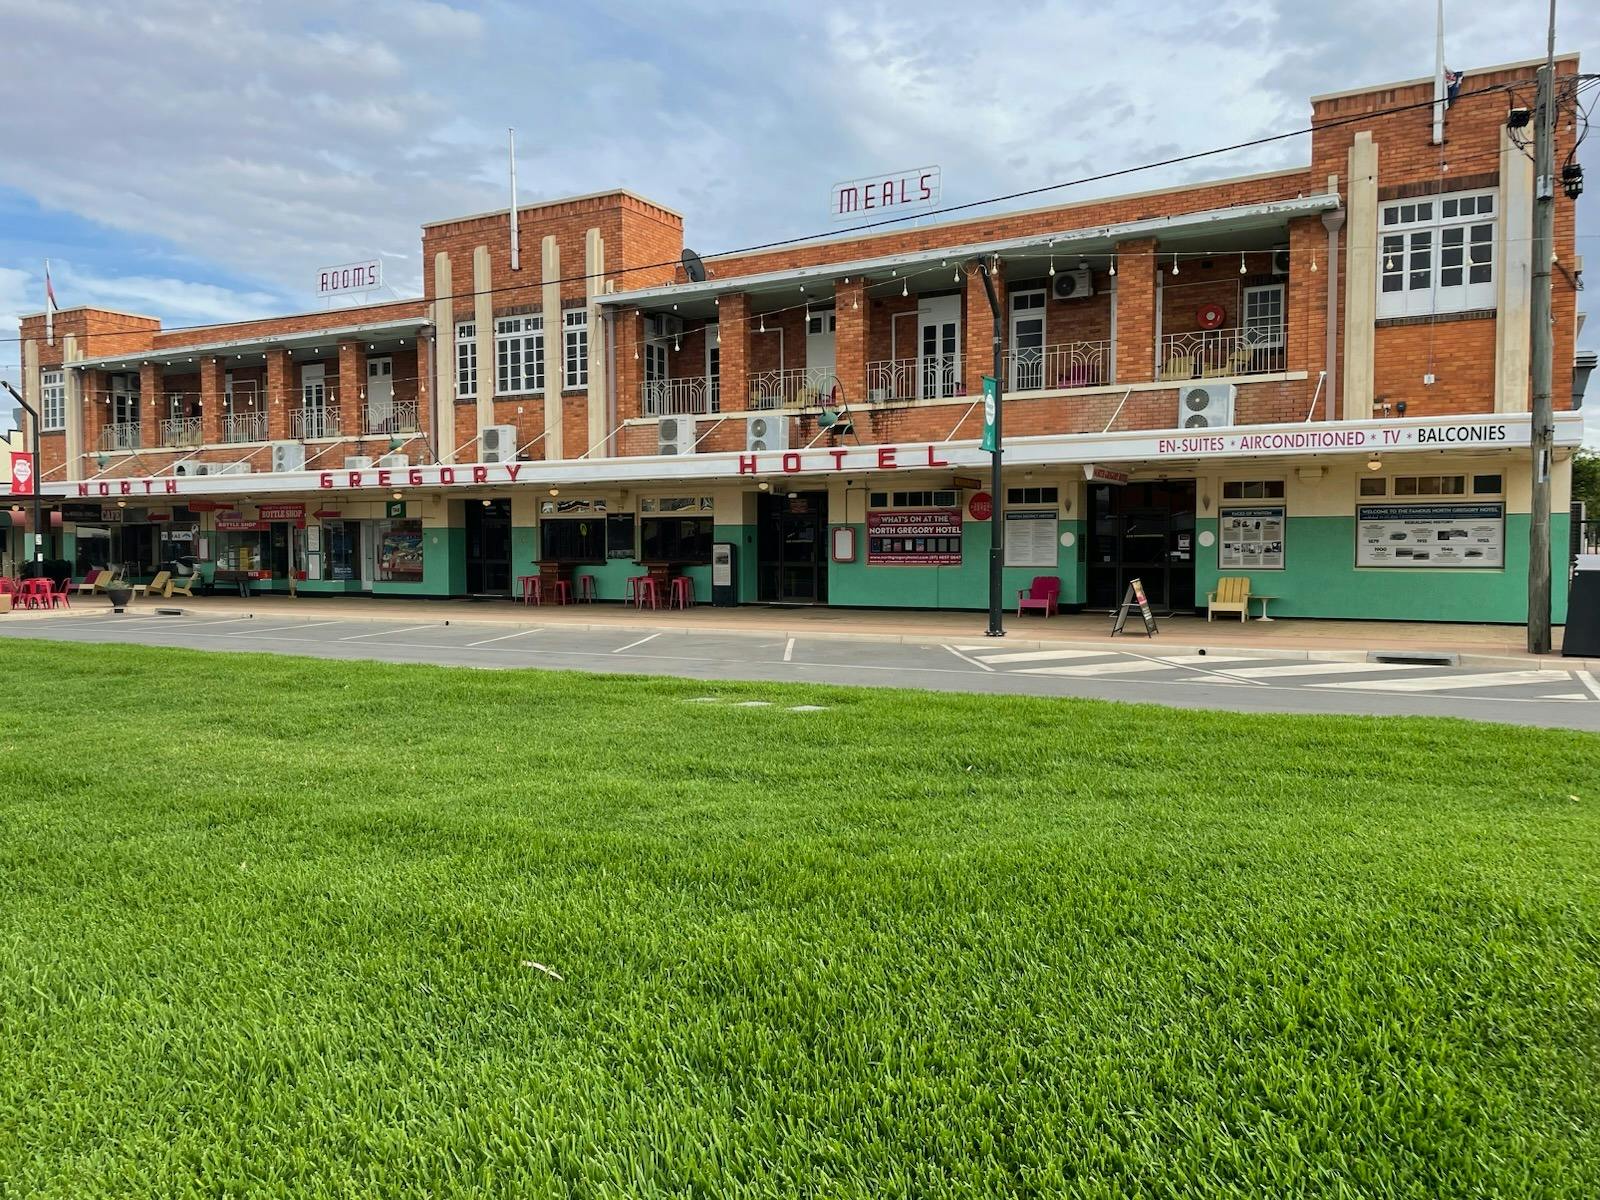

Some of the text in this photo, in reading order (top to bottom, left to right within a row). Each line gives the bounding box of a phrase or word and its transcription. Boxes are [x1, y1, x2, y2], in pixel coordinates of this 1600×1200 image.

[840, 174, 931, 213] MEALS
[321, 265, 376, 291] ROOMS
[1159, 425, 1506, 453] EN-SUITES AIRCONDITIONED TV BALCONIES
[78, 445, 949, 496] NORTH GREGORY HOTEL
[261, 510, 303, 518] BOTTLE SHOP
[881, 515, 908, 523] WHAT'S
[897, 526, 935, 534] GREGORY
[935, 526, 962, 534] HOTEL
